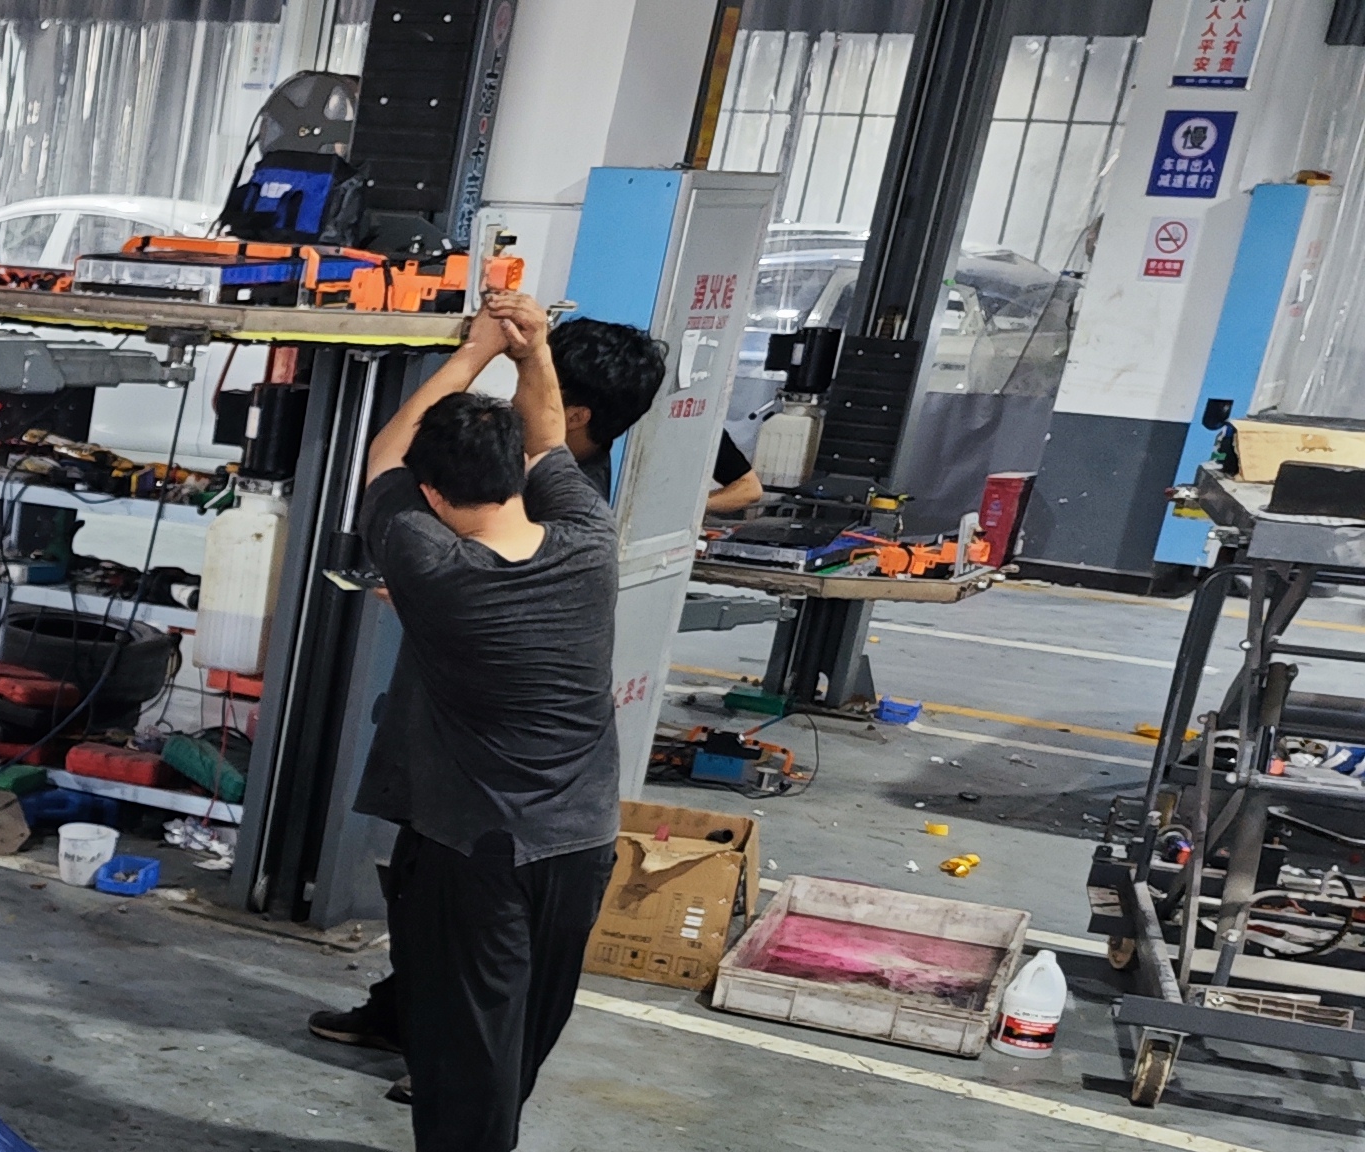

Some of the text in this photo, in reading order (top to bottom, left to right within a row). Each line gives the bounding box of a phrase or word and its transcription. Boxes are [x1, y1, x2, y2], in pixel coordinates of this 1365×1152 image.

[1192, 0, 1226, 72] 人人平安
[1217, 0, 1247, 72] 人人有责
